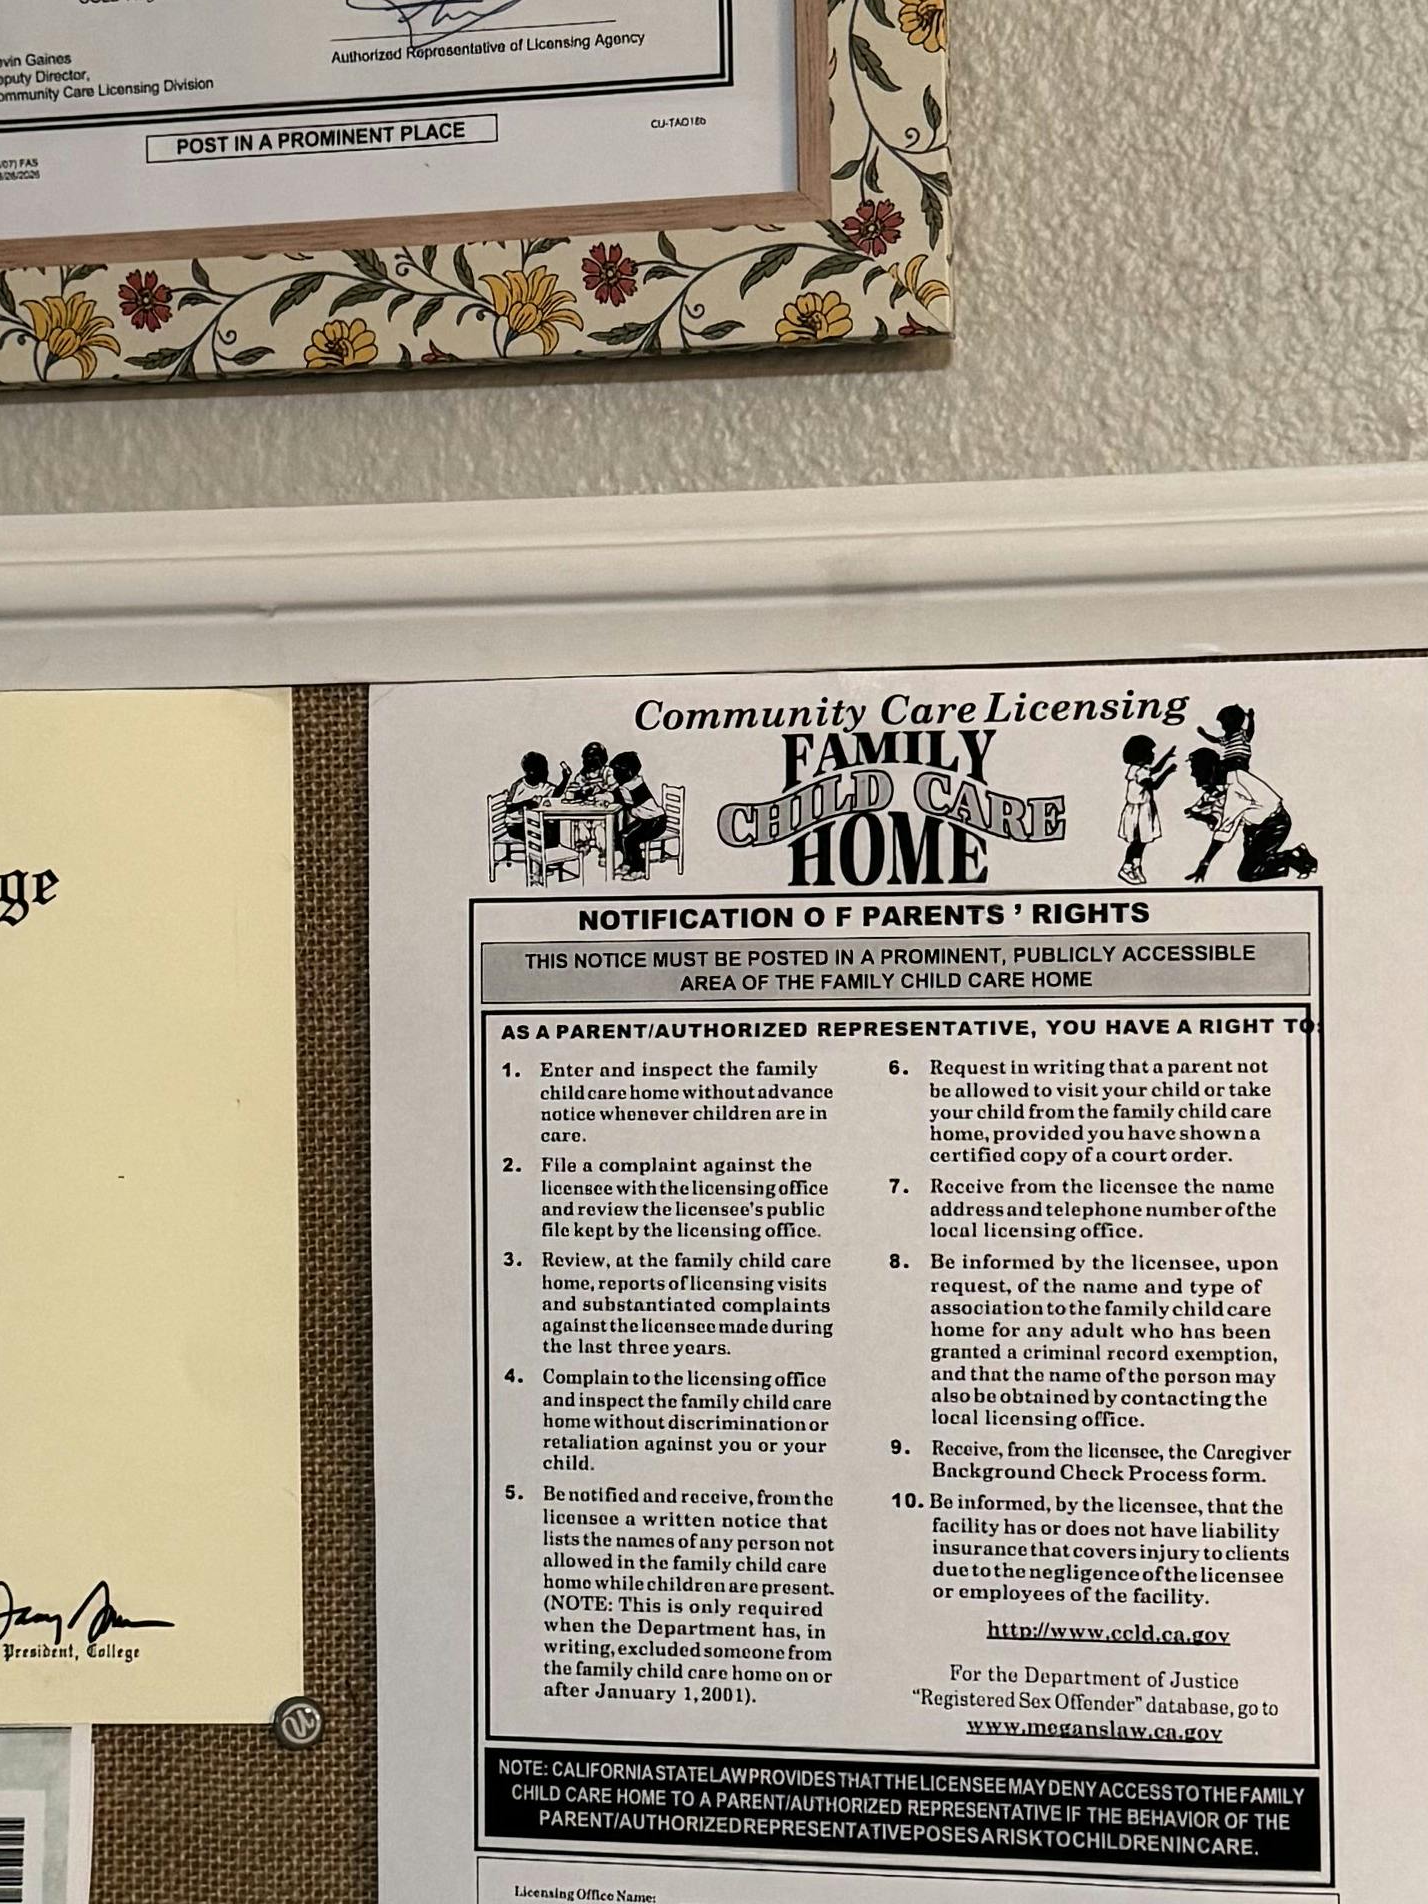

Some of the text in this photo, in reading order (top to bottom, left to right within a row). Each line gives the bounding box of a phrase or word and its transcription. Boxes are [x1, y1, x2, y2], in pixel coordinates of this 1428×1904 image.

[175, 120, 466, 156] POST IN A PROMINENT PLACE
[633, 688, 1190, 734] Community Care Licensing
[782, 729, 997, 794] FAMILY
[717, 770, 1068, 852] CHILD CARE
[786, 810, 990, 888] HOME
[578, 906, 793, 931] NOTIFICATION
[1031, 900, 1150, 925] RIGHTS
[523, 943, 1256, 970] THIS NOTICE MUST BE POSTED IN A PROMINENT, PUBLICLY ACCESSIBLE
[678, 970, 1093, 992] AREA OF THE FAMILY CHILD CARE HOME
[539, 1058, 818, 1081] Enter and inspect the family
[985, 1618, 1231, 1647] http://www.ccld.ca.gov
[1, 1641, 140, 1664] President, College
[964, 1718, 1224, 1744] www.meganslaw.ca.gov
